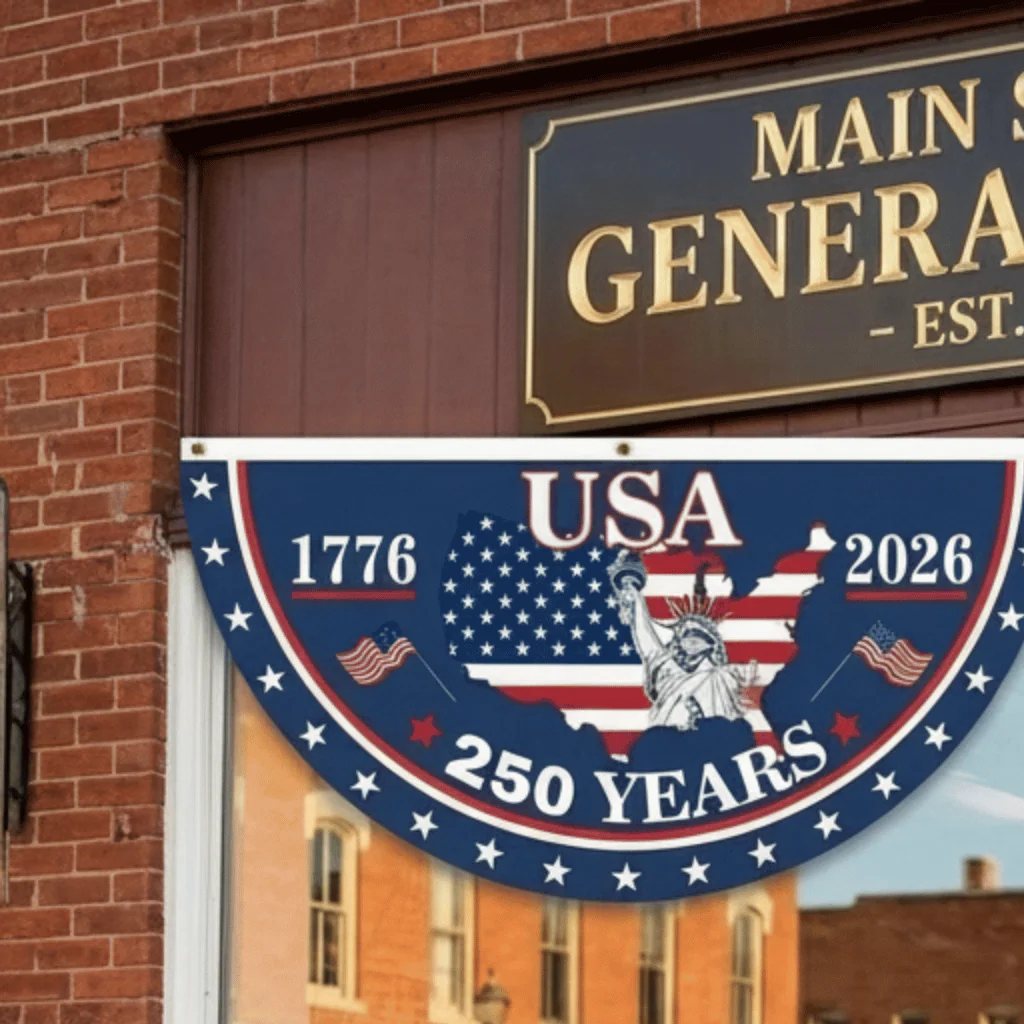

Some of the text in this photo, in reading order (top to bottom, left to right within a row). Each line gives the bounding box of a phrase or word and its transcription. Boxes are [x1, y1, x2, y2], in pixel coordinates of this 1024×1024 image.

[752, 80, 981, 181] MAIN
[913, 291, 1024, 349] EST.
[522, 471, 743, 548] USA
[292, 534, 417, 585] 1776
[845, 533, 973, 585] 2026
[444, 719, 828, 823] 250 YEARS
